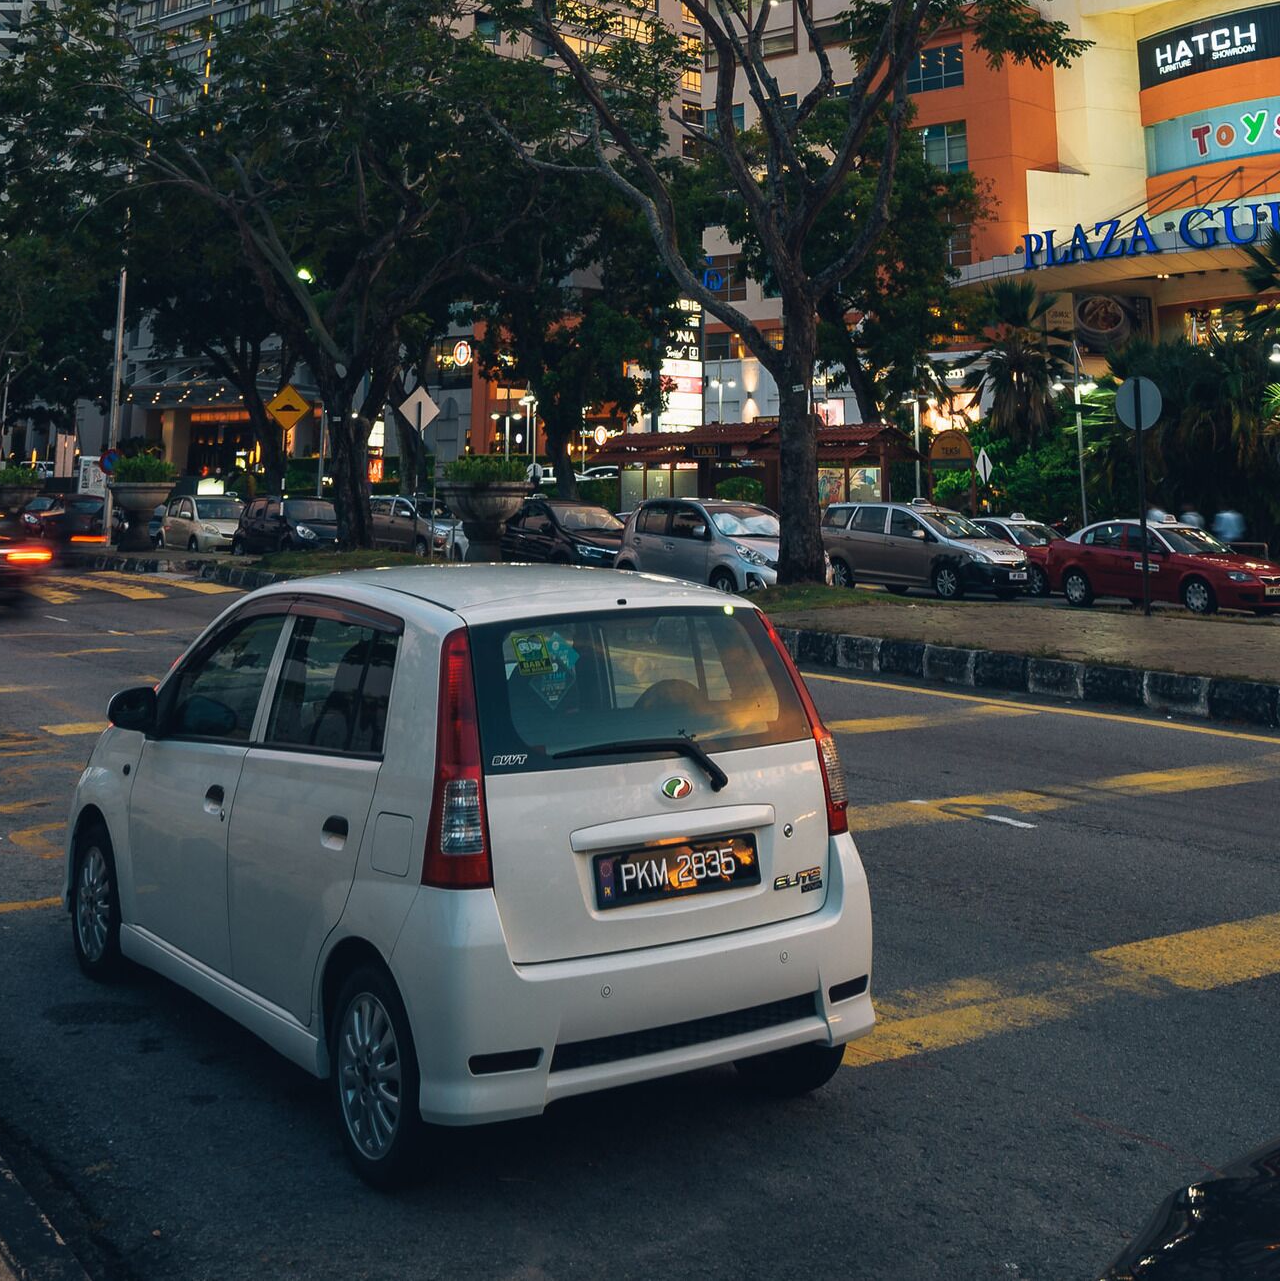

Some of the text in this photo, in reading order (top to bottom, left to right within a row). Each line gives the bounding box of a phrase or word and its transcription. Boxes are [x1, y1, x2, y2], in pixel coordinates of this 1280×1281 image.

[1155, 23, 1257, 68] HATCH
[1212, 44, 1256, 60] SHOWROOM
[1159, 58, 1192, 75] FURNITURE
[1021, 214, 1160, 270] PLAZA
[696, 446, 716, 455] TAXI
[620, 848, 736, 892] PKM 2835
